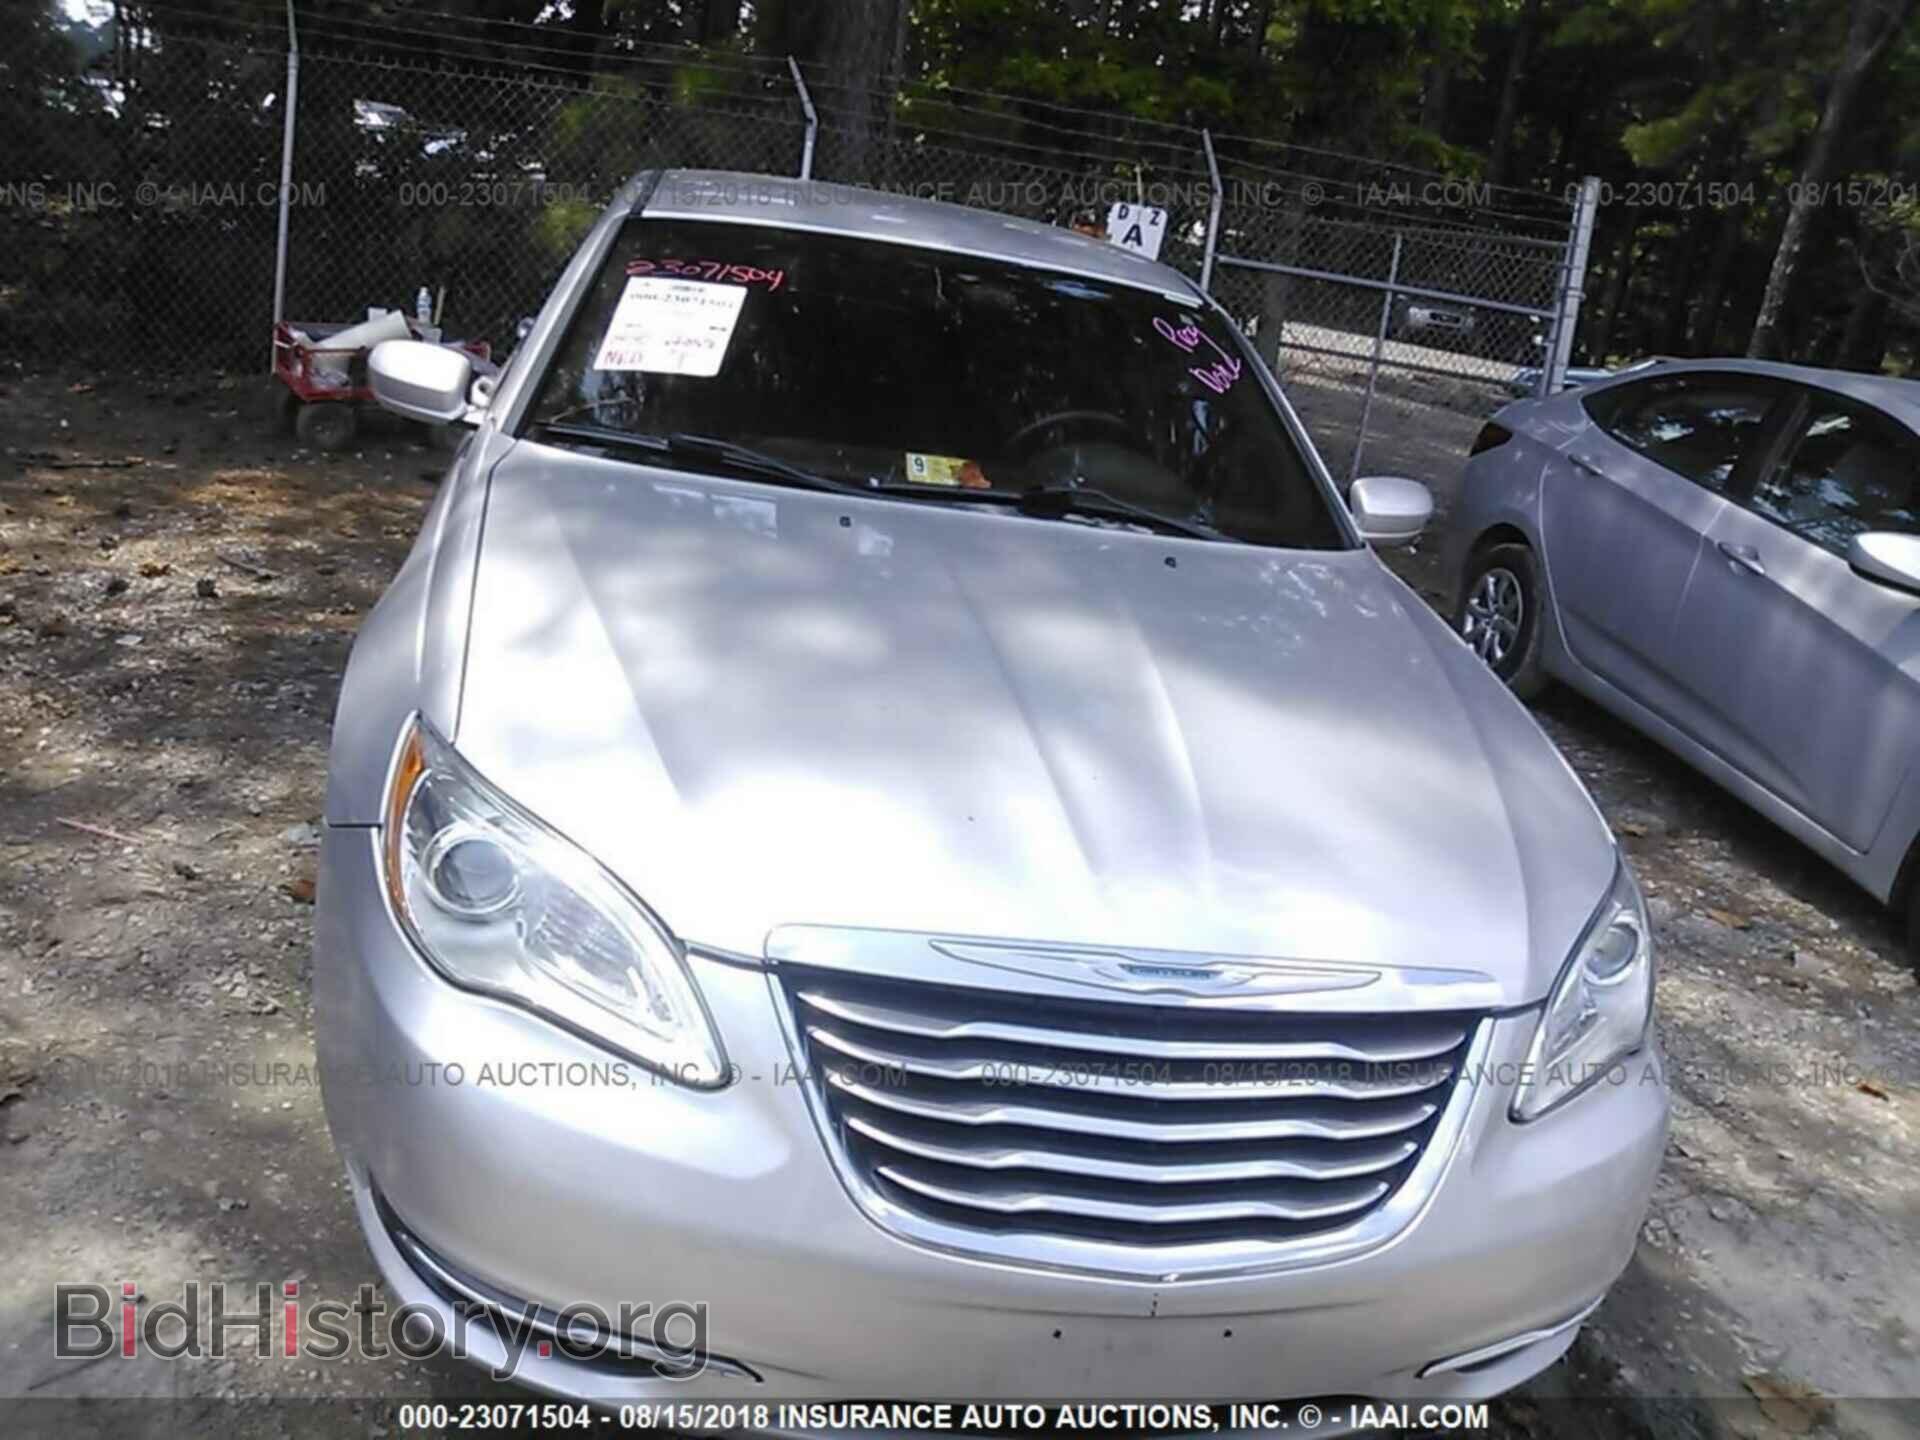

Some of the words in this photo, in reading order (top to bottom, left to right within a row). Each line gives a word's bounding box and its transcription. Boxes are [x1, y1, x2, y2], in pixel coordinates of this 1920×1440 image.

[1122, 224, 1143, 246] A
[625, 259, 784, 292] 23071504
[914, 456, 925, 473] 9
